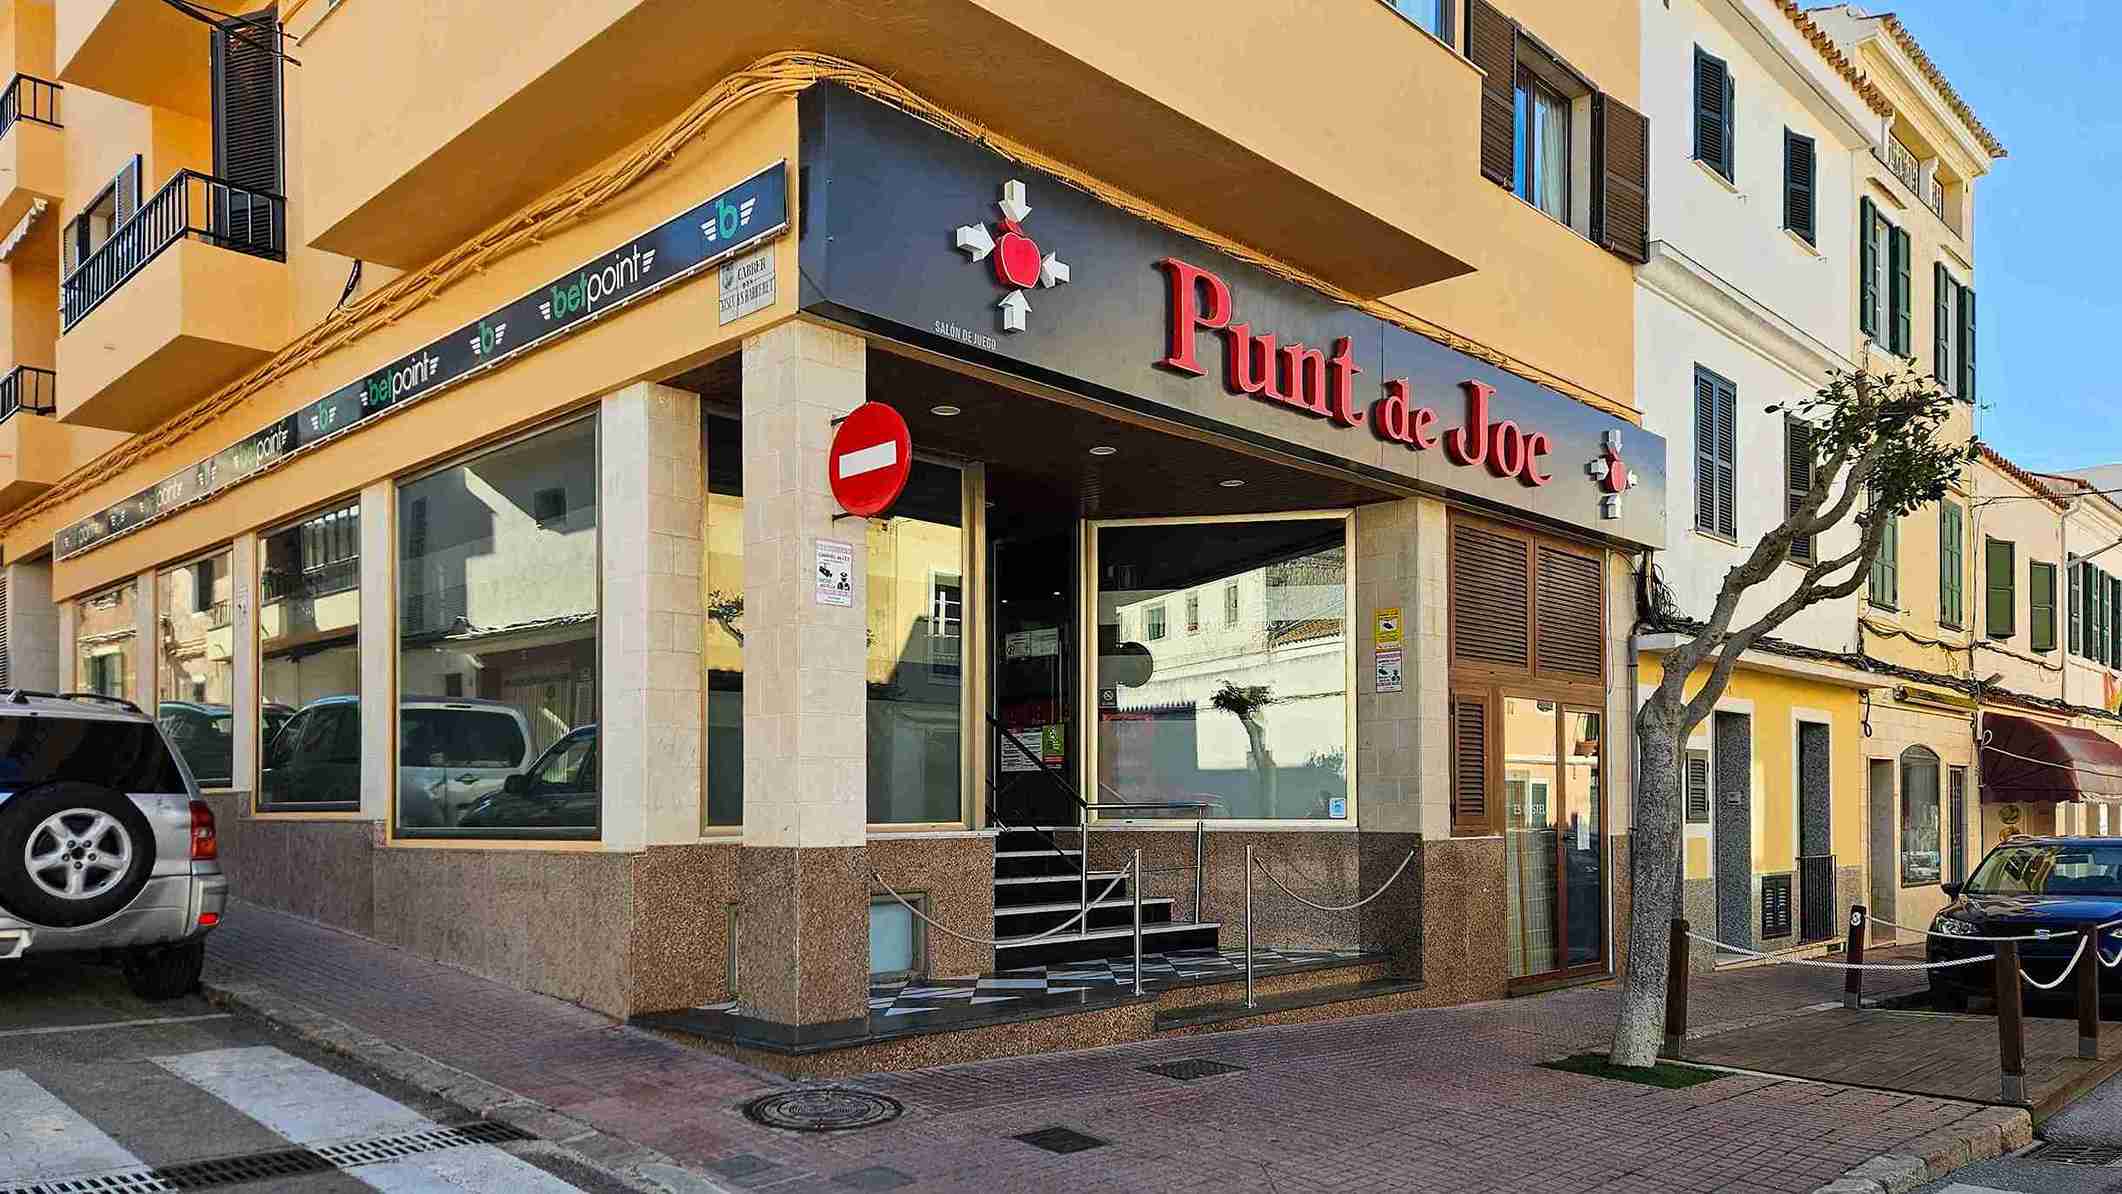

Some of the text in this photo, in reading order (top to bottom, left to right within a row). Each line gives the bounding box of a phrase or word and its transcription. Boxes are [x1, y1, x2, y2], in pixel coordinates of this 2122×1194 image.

[551, 245, 640, 320] betpoint
[935, 319, 997, 350] SALÓN DE JUEGO
[368, 352, 429, 405] betpoint
[1160, 257, 1553, 487] Punt de Joc
